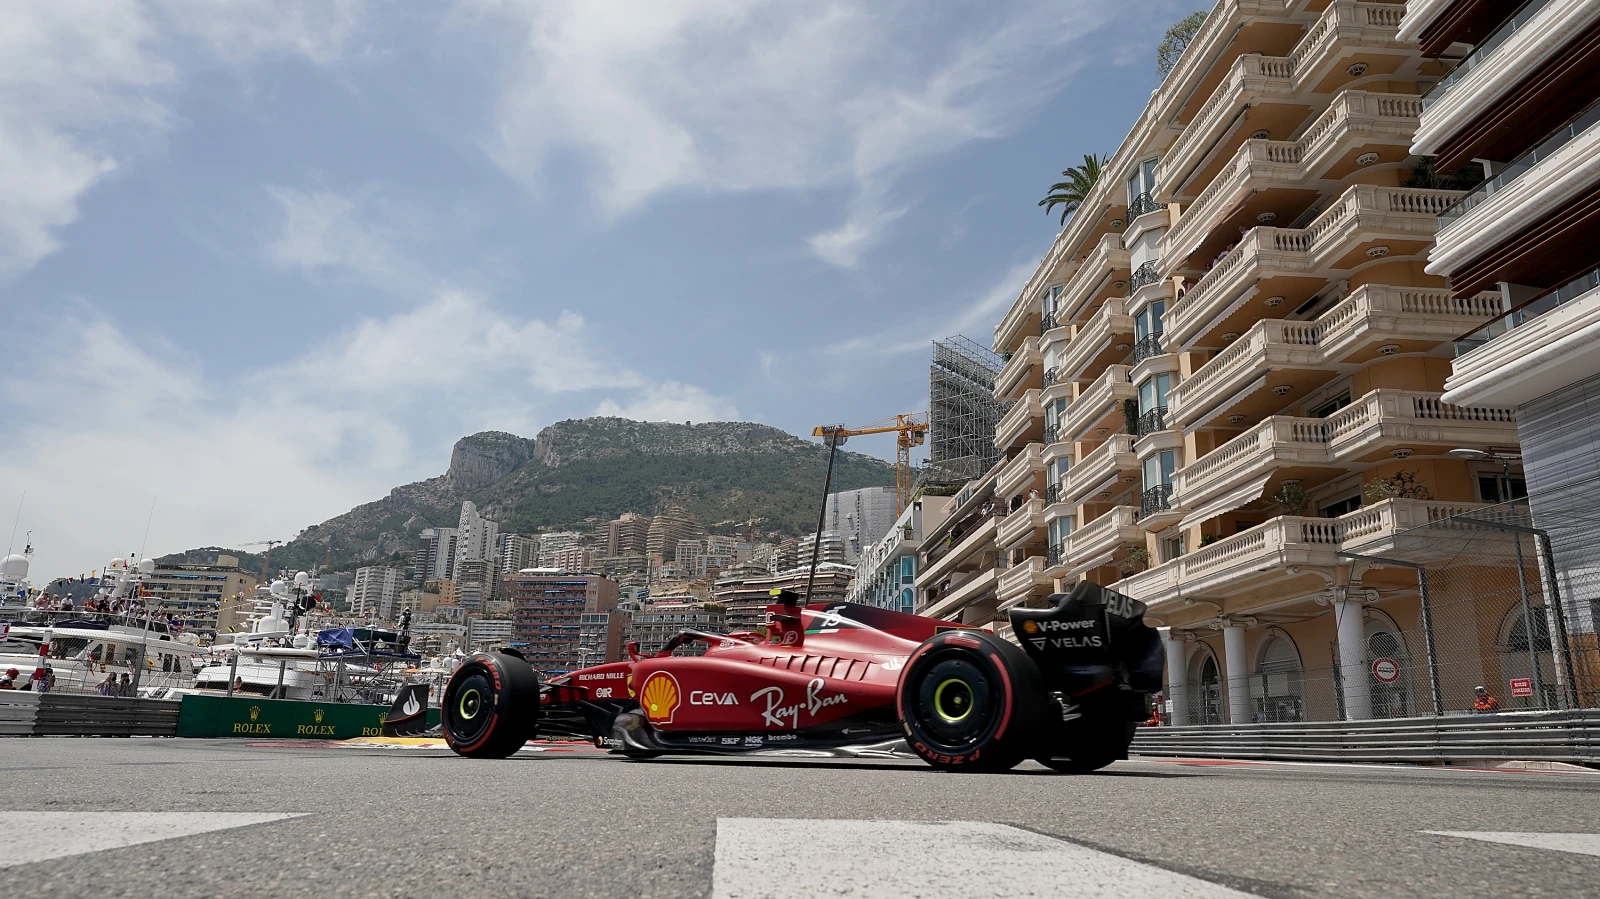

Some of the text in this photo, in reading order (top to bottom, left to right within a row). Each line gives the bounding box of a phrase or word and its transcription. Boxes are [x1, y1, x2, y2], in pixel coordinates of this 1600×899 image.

[1101, 588, 1134, 619] VELAS
[1037, 620, 1096, 632] V-Power
[1051, 635, 1103, 648] VELAS
[579, 672, 625, 681] RICHARD MILLE
[232, 723, 272, 734] ROLEX
[297, 725, 336, 735] ROLEX
[720, 737, 741, 745] SKF
[744, 735, 763, 744] NGK
[768, 733, 798, 741] brembo
[914, 741, 980, 765] P ZERO
